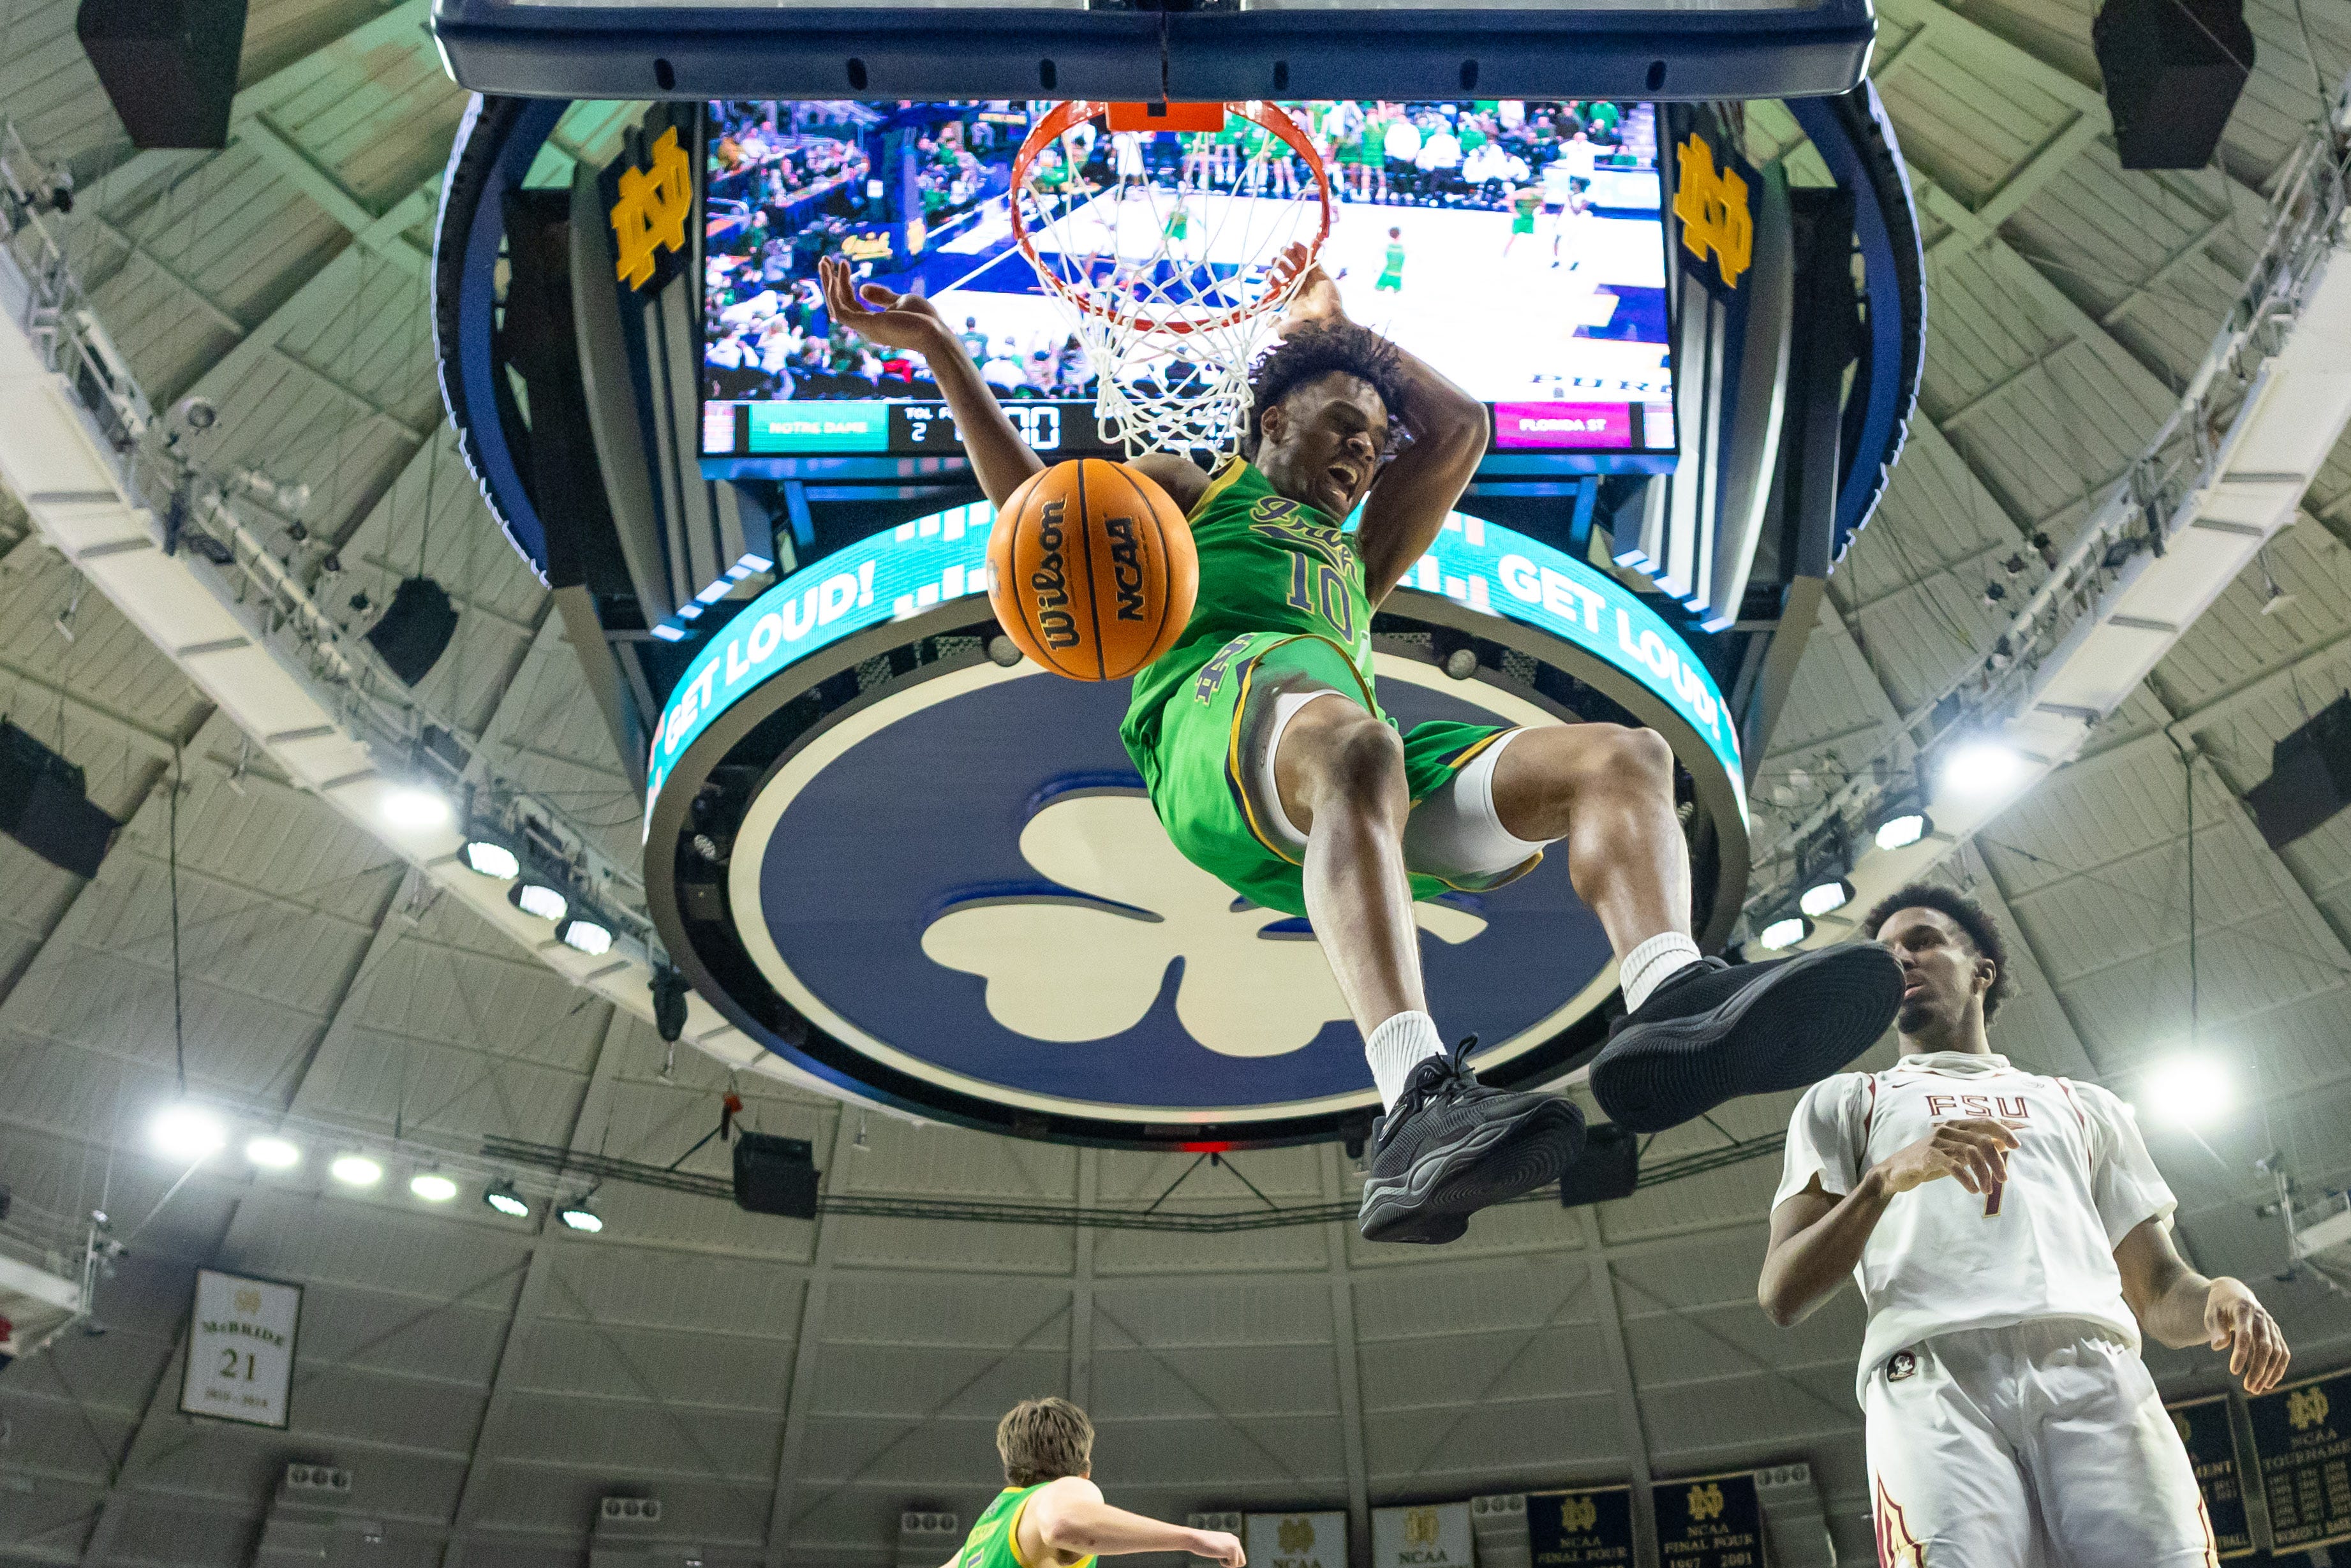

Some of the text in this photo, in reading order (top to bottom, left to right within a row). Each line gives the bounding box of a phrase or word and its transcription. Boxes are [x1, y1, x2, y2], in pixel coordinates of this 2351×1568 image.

[904, 407, 933, 420] TOL
[769, 421, 868, 434] NOTRE DAME
[911, 422, 927, 442] 2
[1519, 418, 1607, 432] FLORIDA ST
[1031, 492, 1081, 653] Wilson
[1104, 515, 1146, 623] NCAA
[1285, 549, 1355, 646] 10
[1497, 553, 1721, 741] GET LOUD!
[664, 559, 876, 756] GET LOUD!
[1924, 1094, 2031, 1119] FSU
[221, 1348, 255, 1382] 21
[1687, 1523, 1729, 1538] NCAA
[1561, 1535, 1601, 1548] NCAA
[1663, 1533, 1754, 1554] FINAL FOUR
[1398, 1548, 1447, 1564] NCAA
[1537, 1551, 1582, 1563] FINAL
